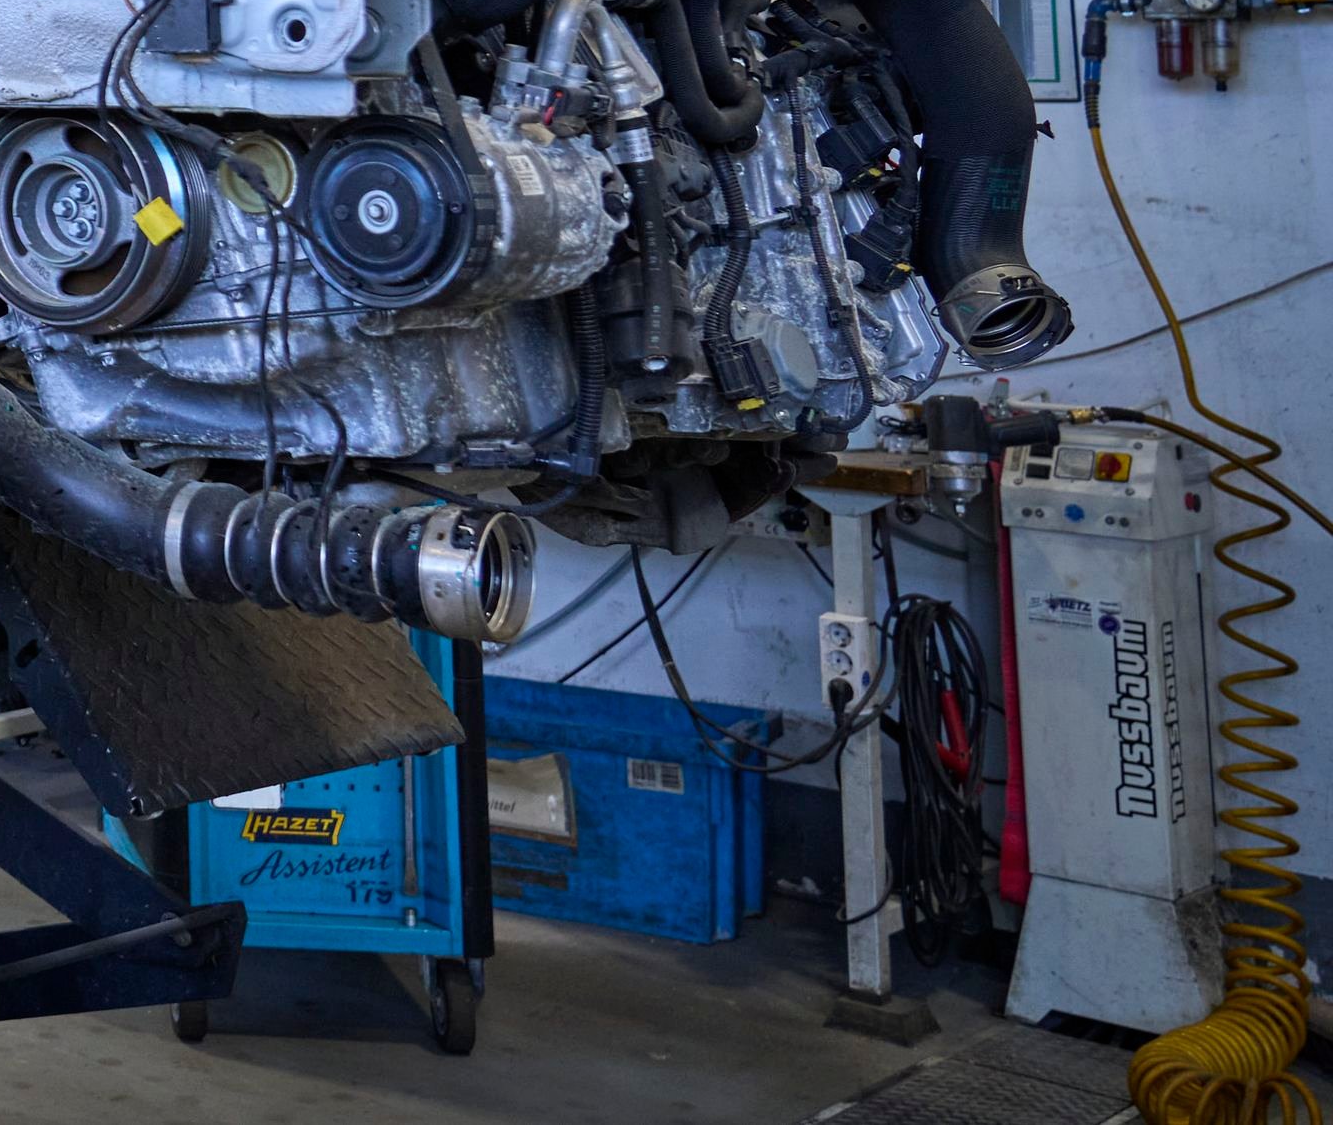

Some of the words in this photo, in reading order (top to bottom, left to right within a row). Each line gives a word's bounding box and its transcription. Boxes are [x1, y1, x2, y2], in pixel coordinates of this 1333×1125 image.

[487, 799, 516, 813] ittel
[253, 813, 333, 833] HAZET
[240, 848, 392, 886] Assistent
